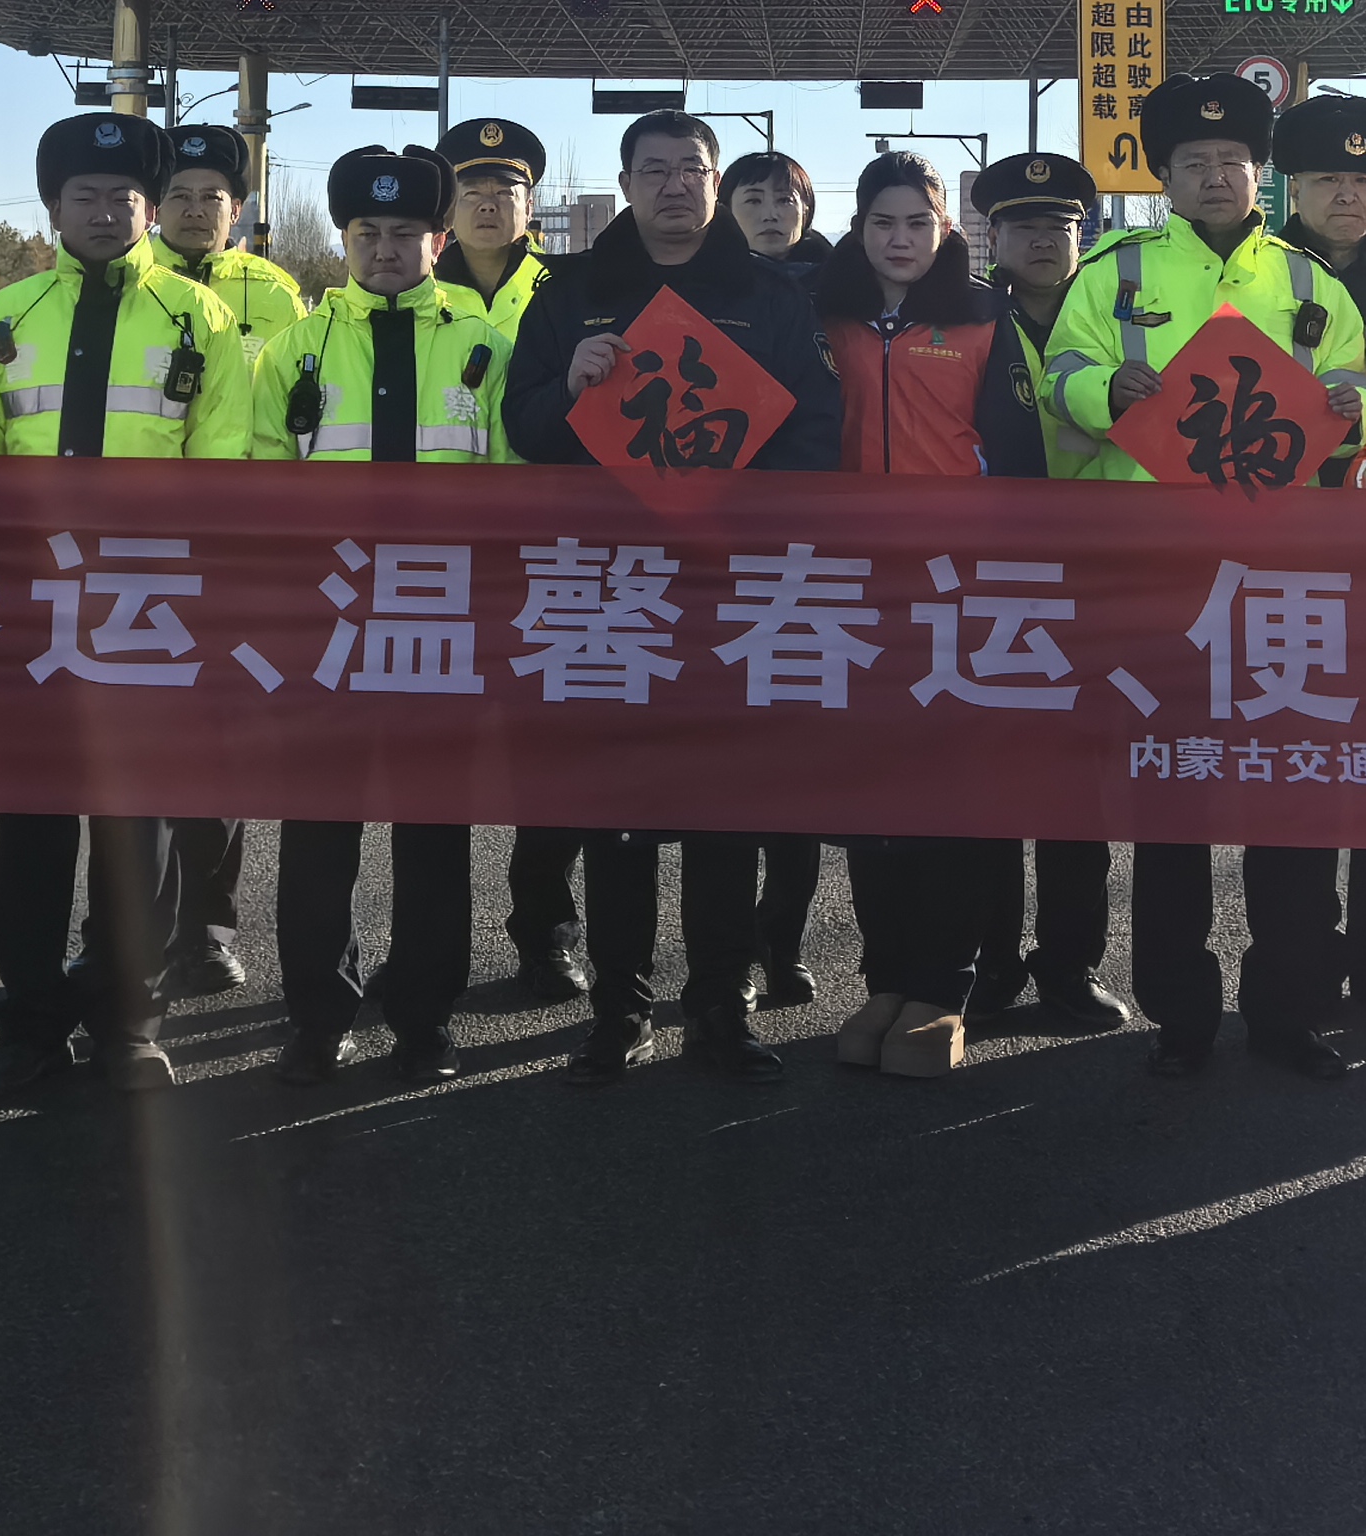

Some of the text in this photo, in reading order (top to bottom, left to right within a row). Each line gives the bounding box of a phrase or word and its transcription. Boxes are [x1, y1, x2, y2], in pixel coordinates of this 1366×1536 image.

[1091, 1, 1117, 120] 超限超载
[1254, 71, 1272, 95] 5
[620, 335, 749, 478] 福
